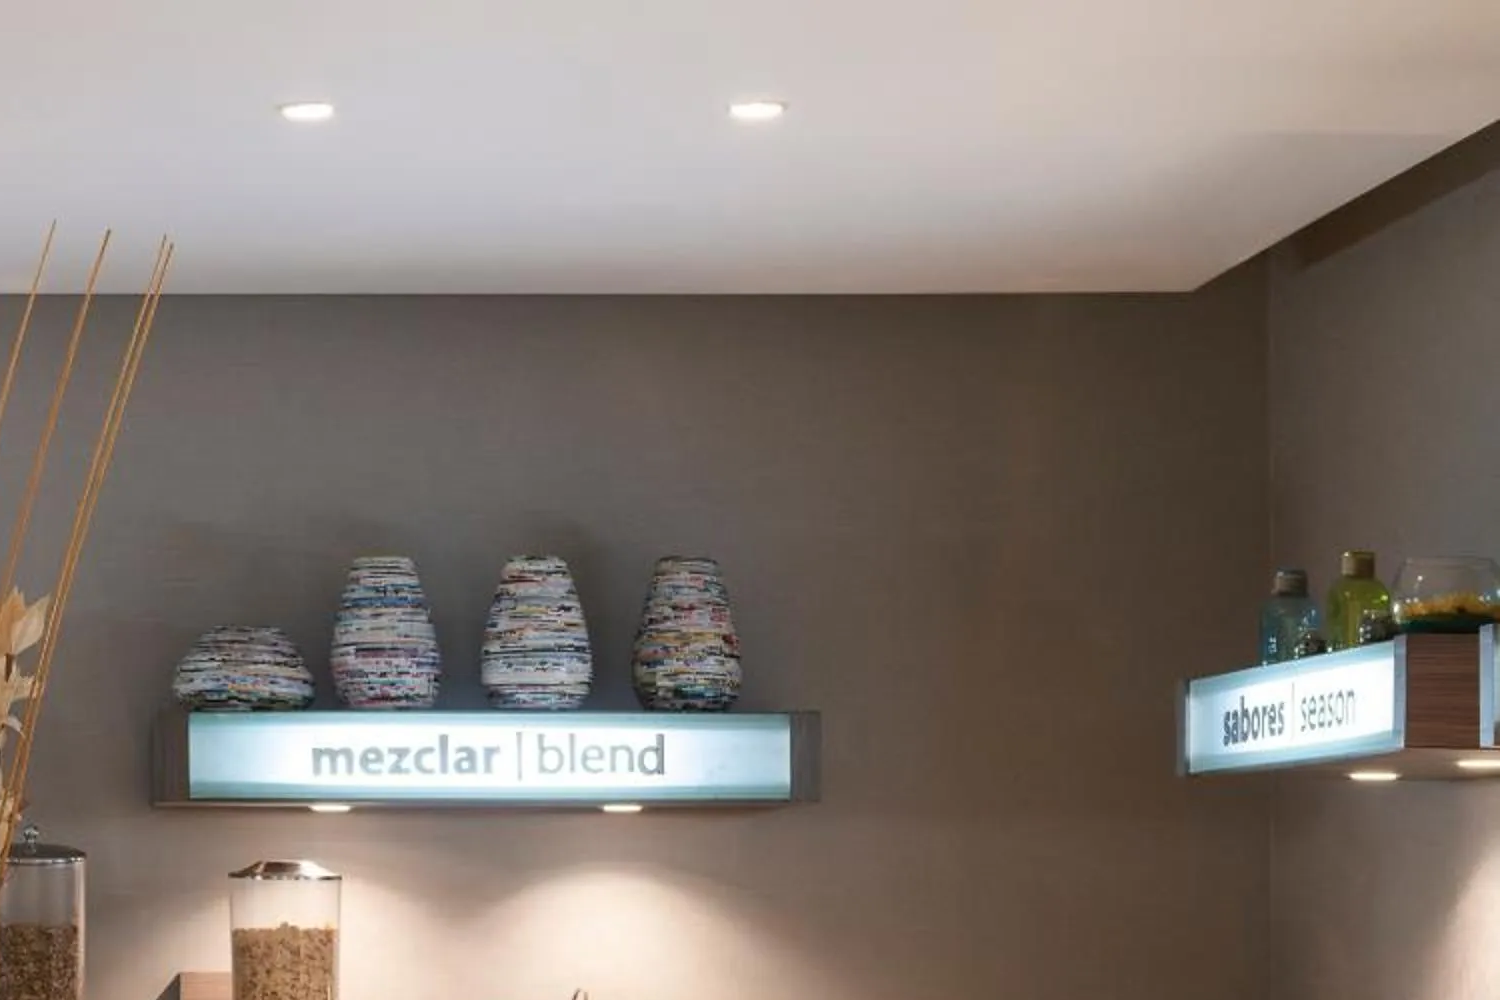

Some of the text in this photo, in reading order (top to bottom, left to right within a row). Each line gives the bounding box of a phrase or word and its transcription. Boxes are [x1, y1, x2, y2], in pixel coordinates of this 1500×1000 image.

[1223, 689, 1356, 746] sabores season
[311, 733, 665, 776] mezclar blend
